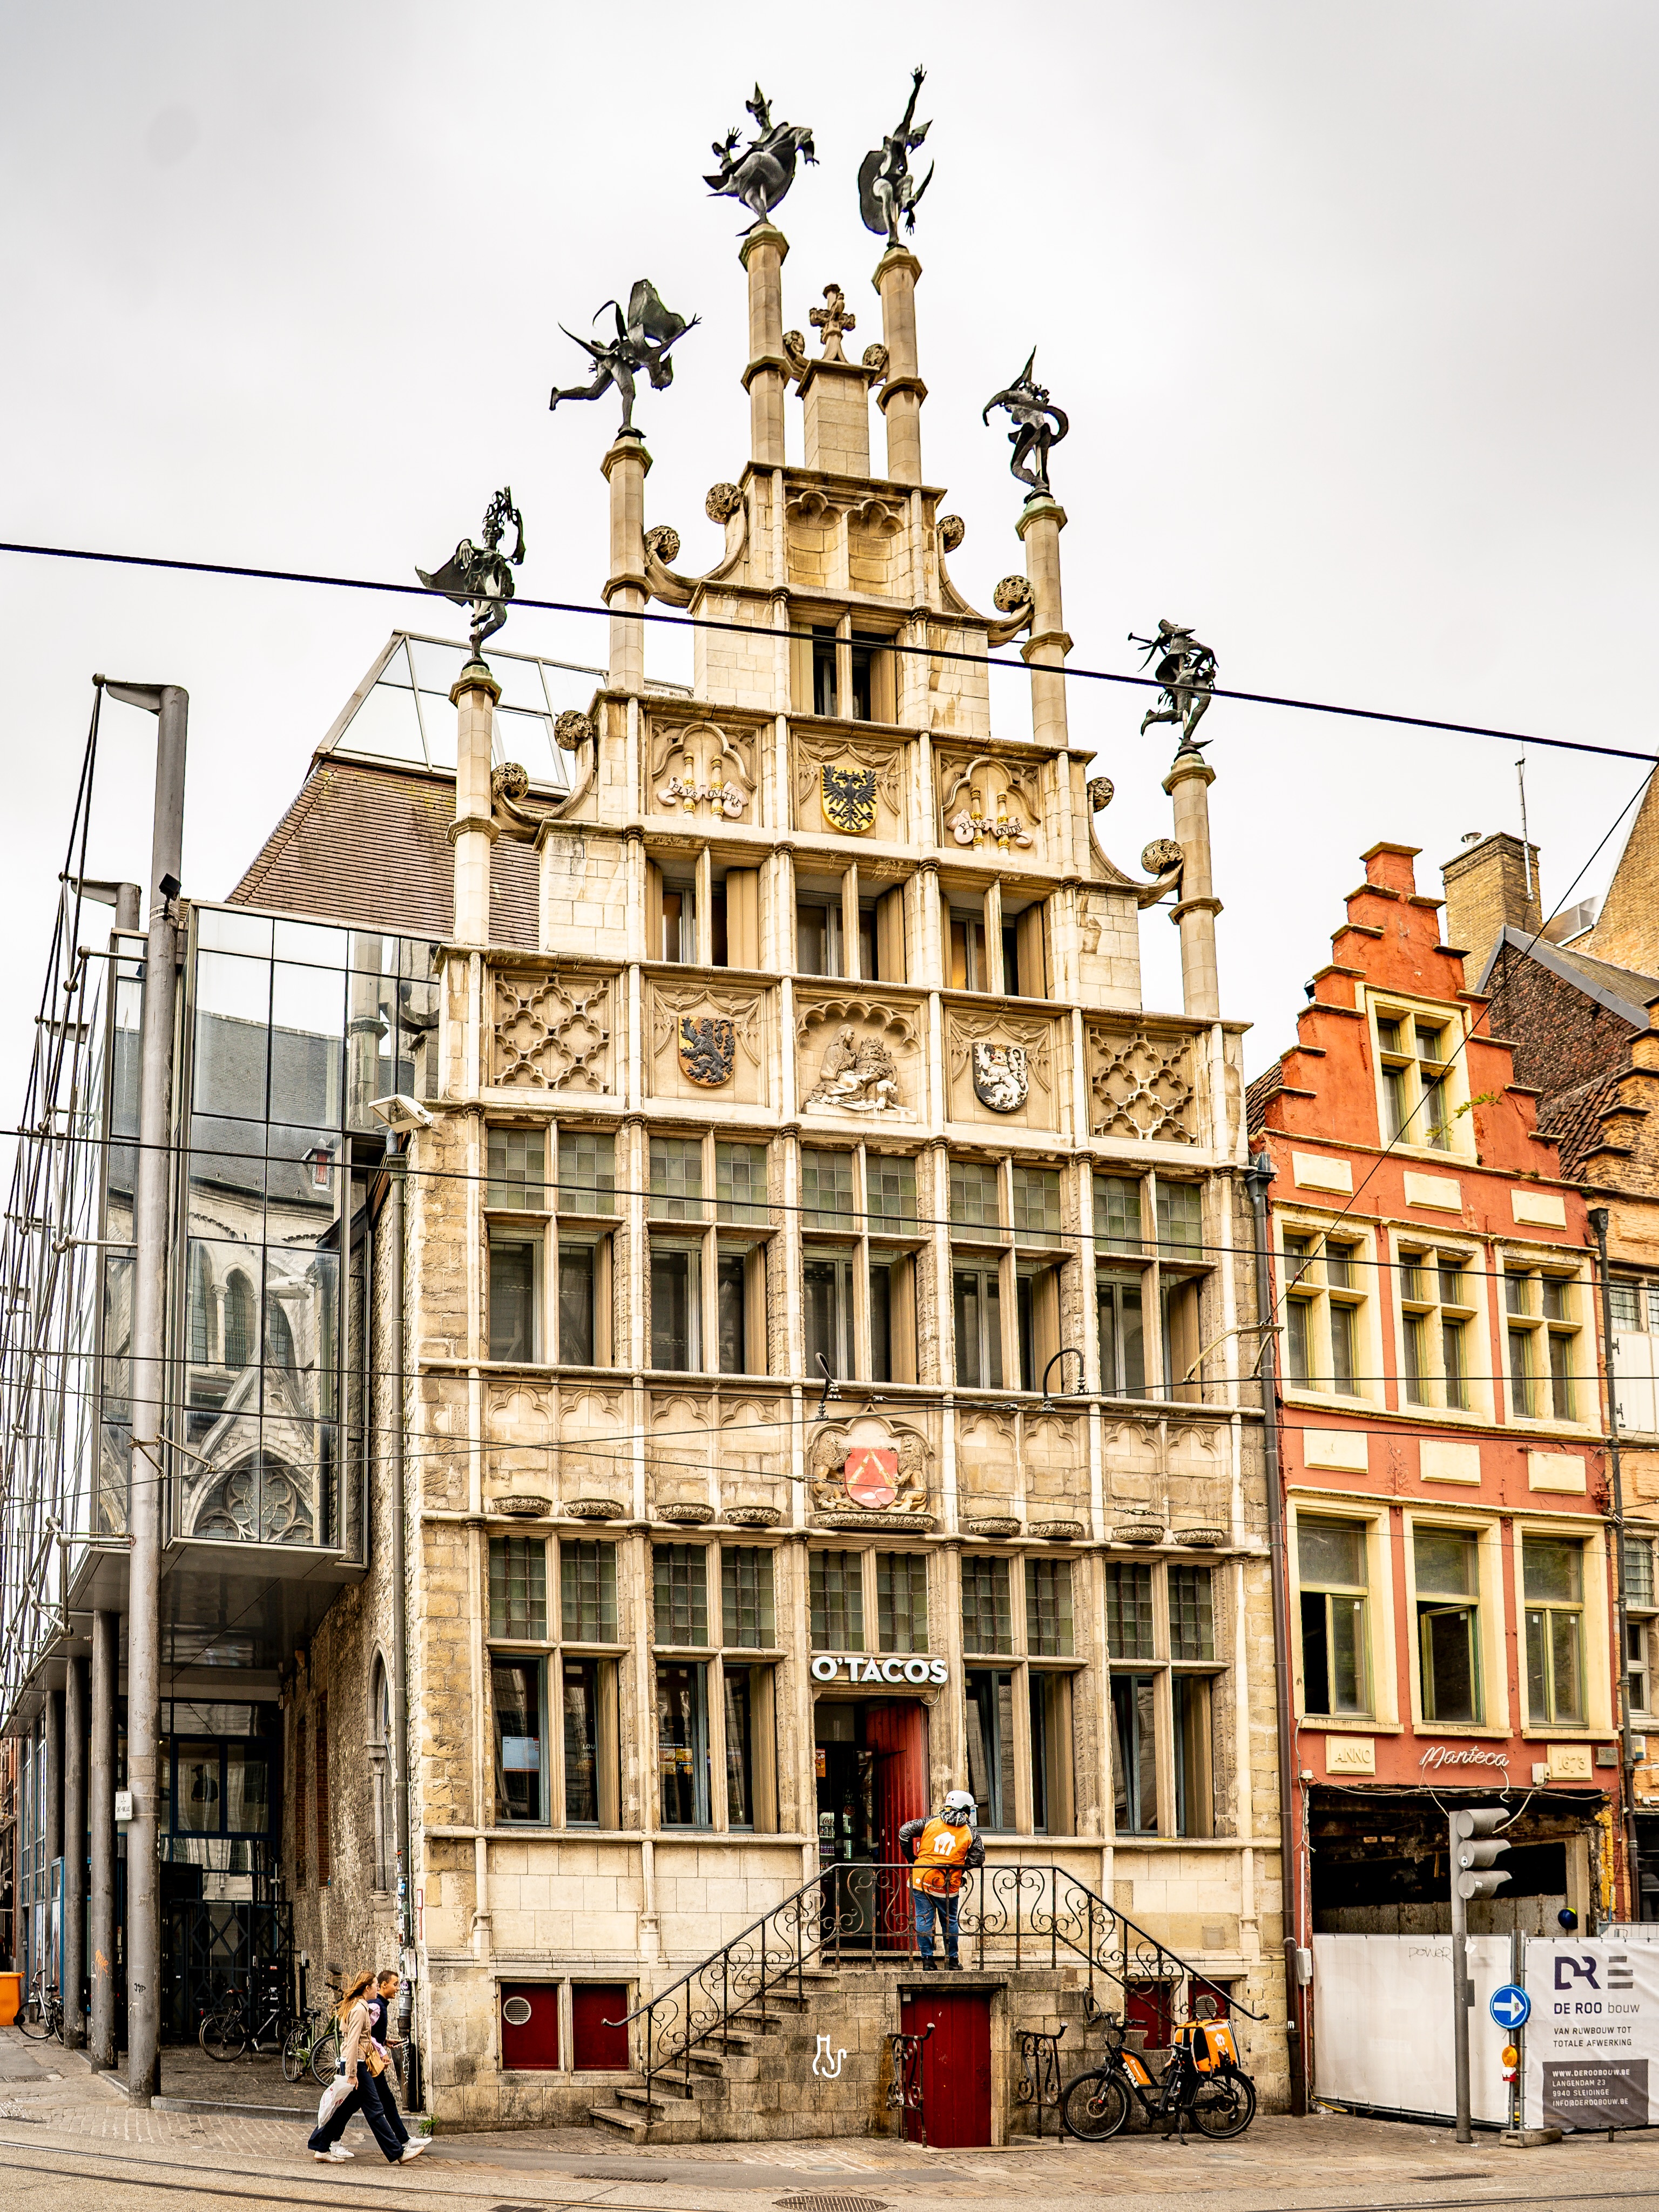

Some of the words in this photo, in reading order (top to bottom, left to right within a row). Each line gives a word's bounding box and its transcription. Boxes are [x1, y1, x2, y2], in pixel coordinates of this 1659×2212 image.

[671, 783, 698, 798] PLVS
[708, 790, 741, 807] OVLTRE
[959, 820, 986, 830] PLVS
[996, 822, 1023, 835] OVLTRE
[811, 1655, 949, 1684] O'TACOS
[1335, 1747, 1372, 1763] ANNO
[1419, 1745, 1510, 1769] Manteca
[1557, 1755, 1587, 1773] 1673
[1554, 2002, 1570, 2014] DE
[1575, 2002, 1602, 2014] ROO
[1608, 2001, 1640, 2013] bouw
[1572, 2026, 1614, 2034] RUWBOUW
[1587, 2039, 1632, 2047] AFWERKING
[1552, 2068, 1630, 2078] WWW.DEROOBOUW.BE
[1573, 2088, 1609, 2096] SLEIDINGE
[1552, 2098, 1629, 2107] INFO@DEROOBOUW.BE
